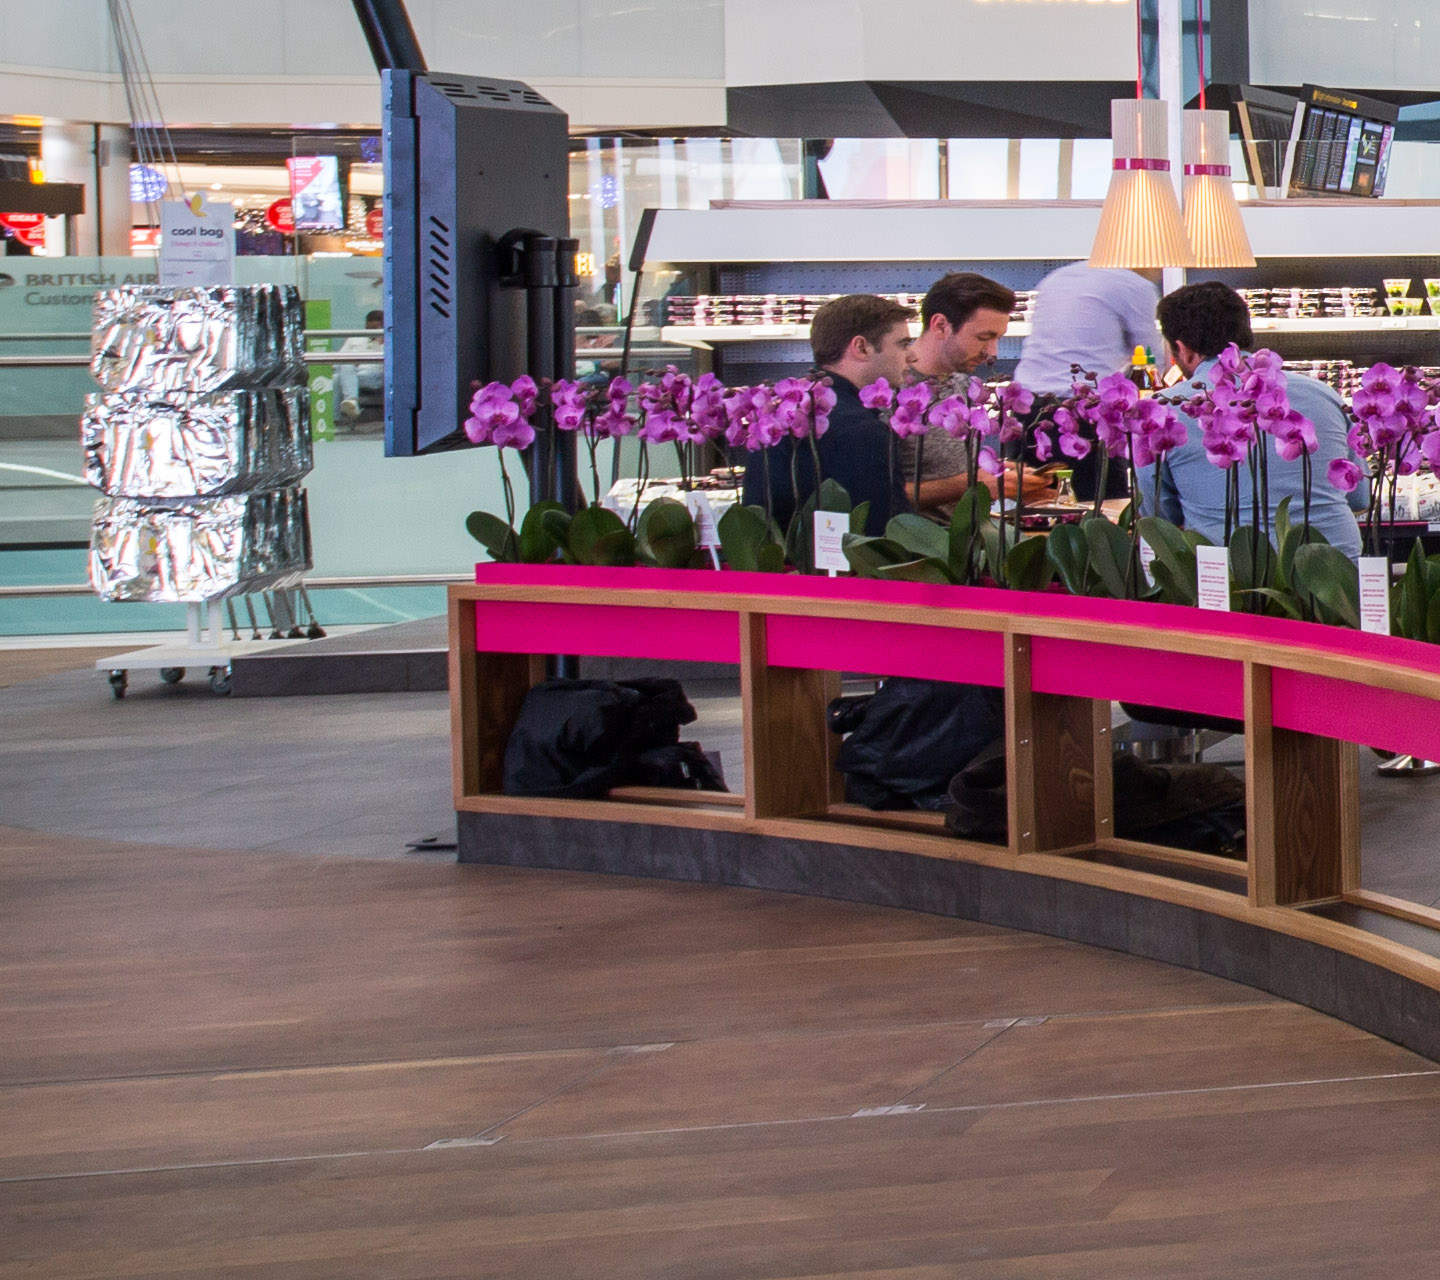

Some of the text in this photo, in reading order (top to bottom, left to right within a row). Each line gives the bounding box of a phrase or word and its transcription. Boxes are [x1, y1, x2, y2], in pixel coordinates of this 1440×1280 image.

[171, 226, 224, 238] cool bag
[25, 273, 116, 286] BRITISH
